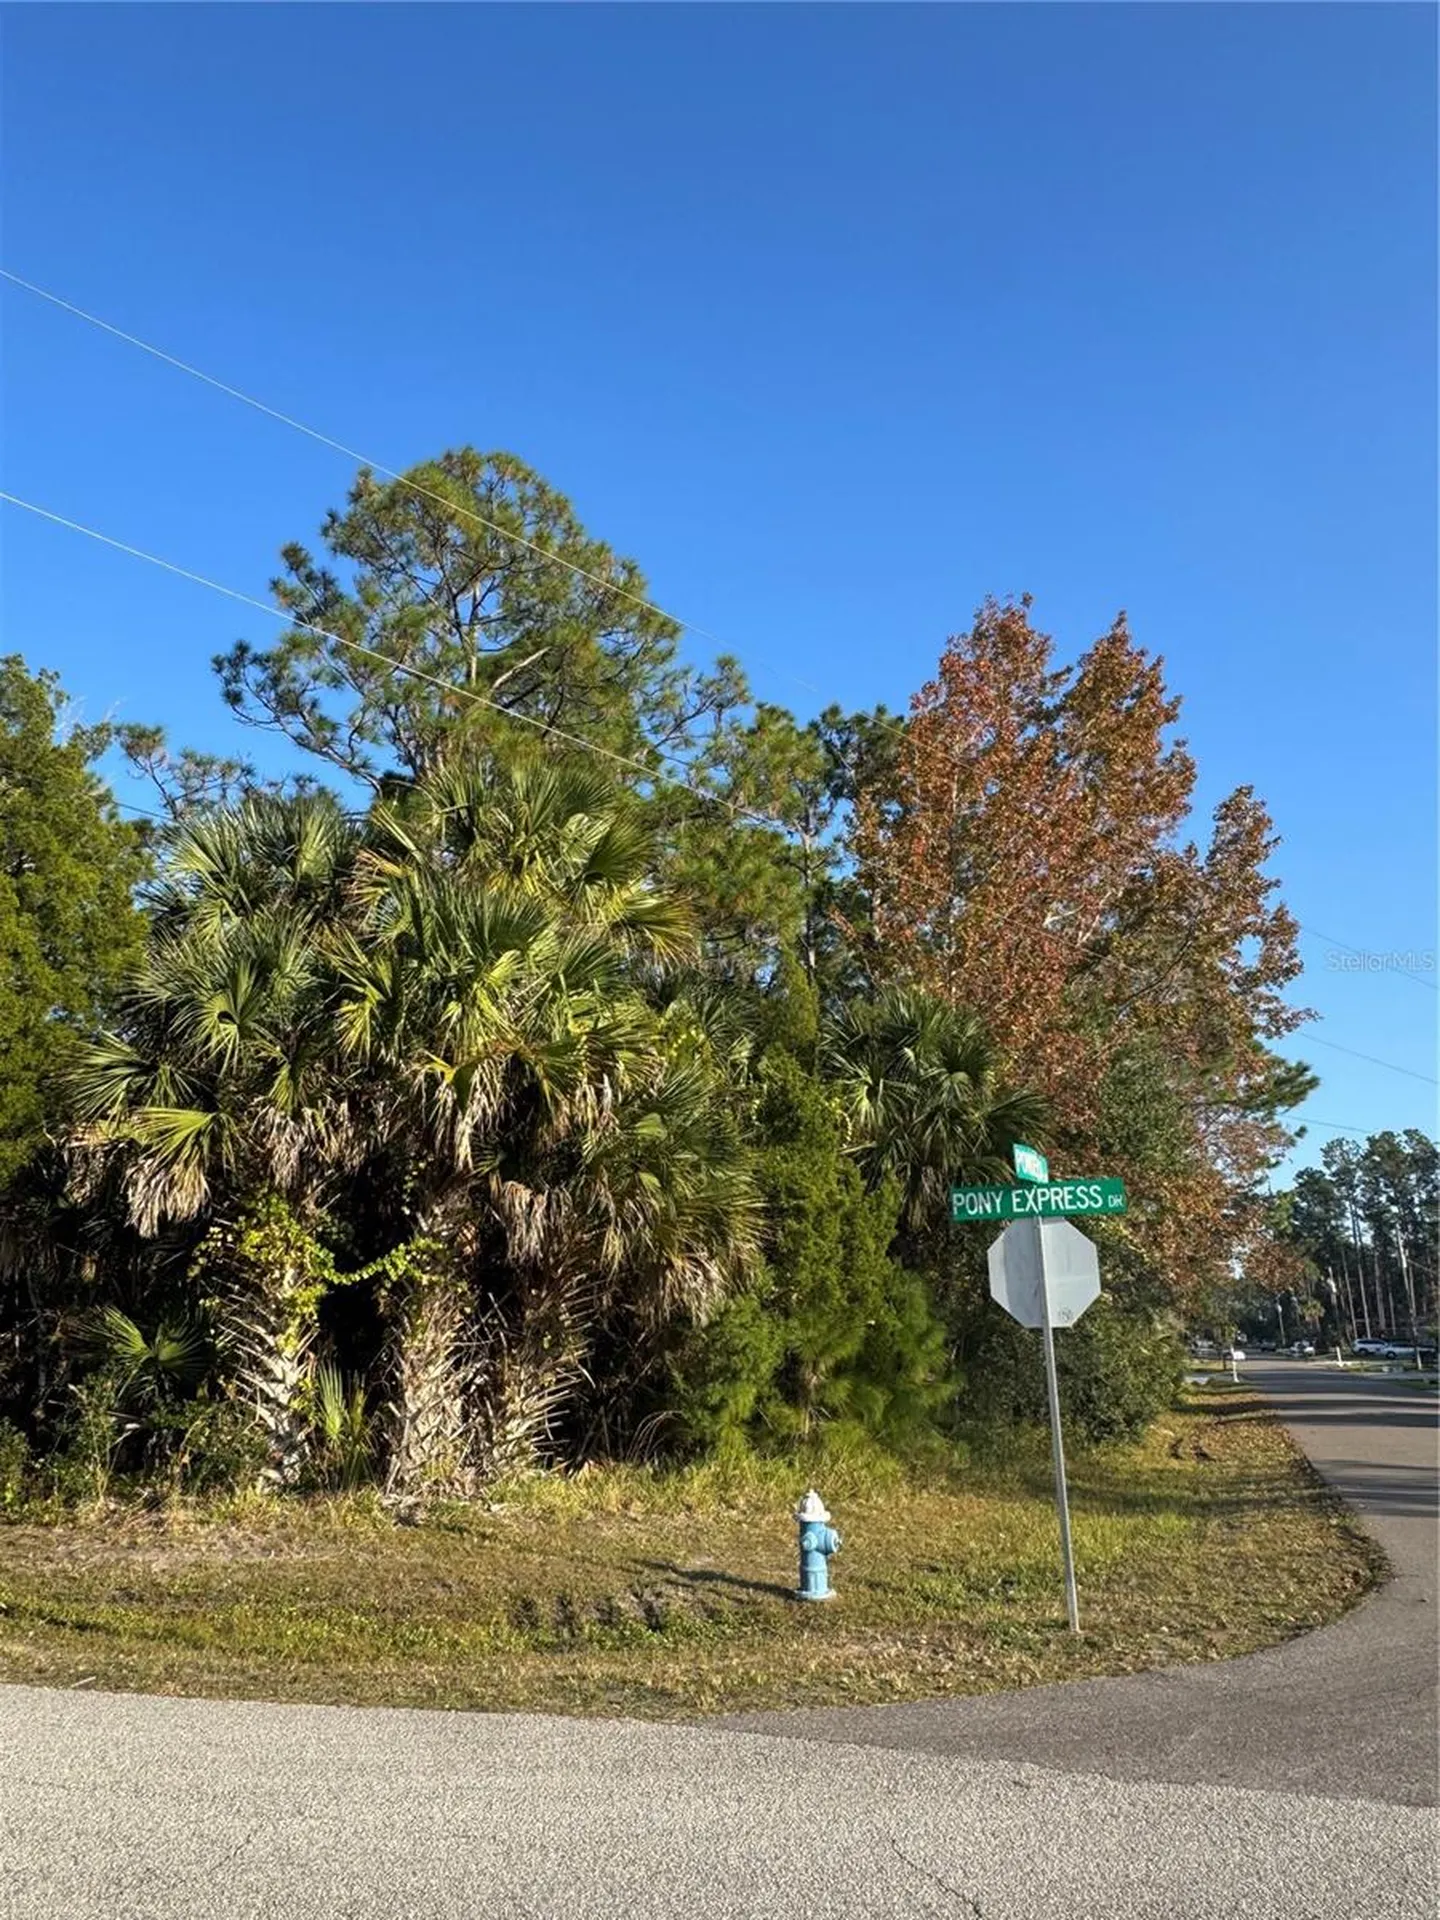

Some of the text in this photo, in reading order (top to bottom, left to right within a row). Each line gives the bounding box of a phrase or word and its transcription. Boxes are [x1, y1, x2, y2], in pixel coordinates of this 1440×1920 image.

[952, 1185, 1123, 1215] PONY EXPRESS DR
